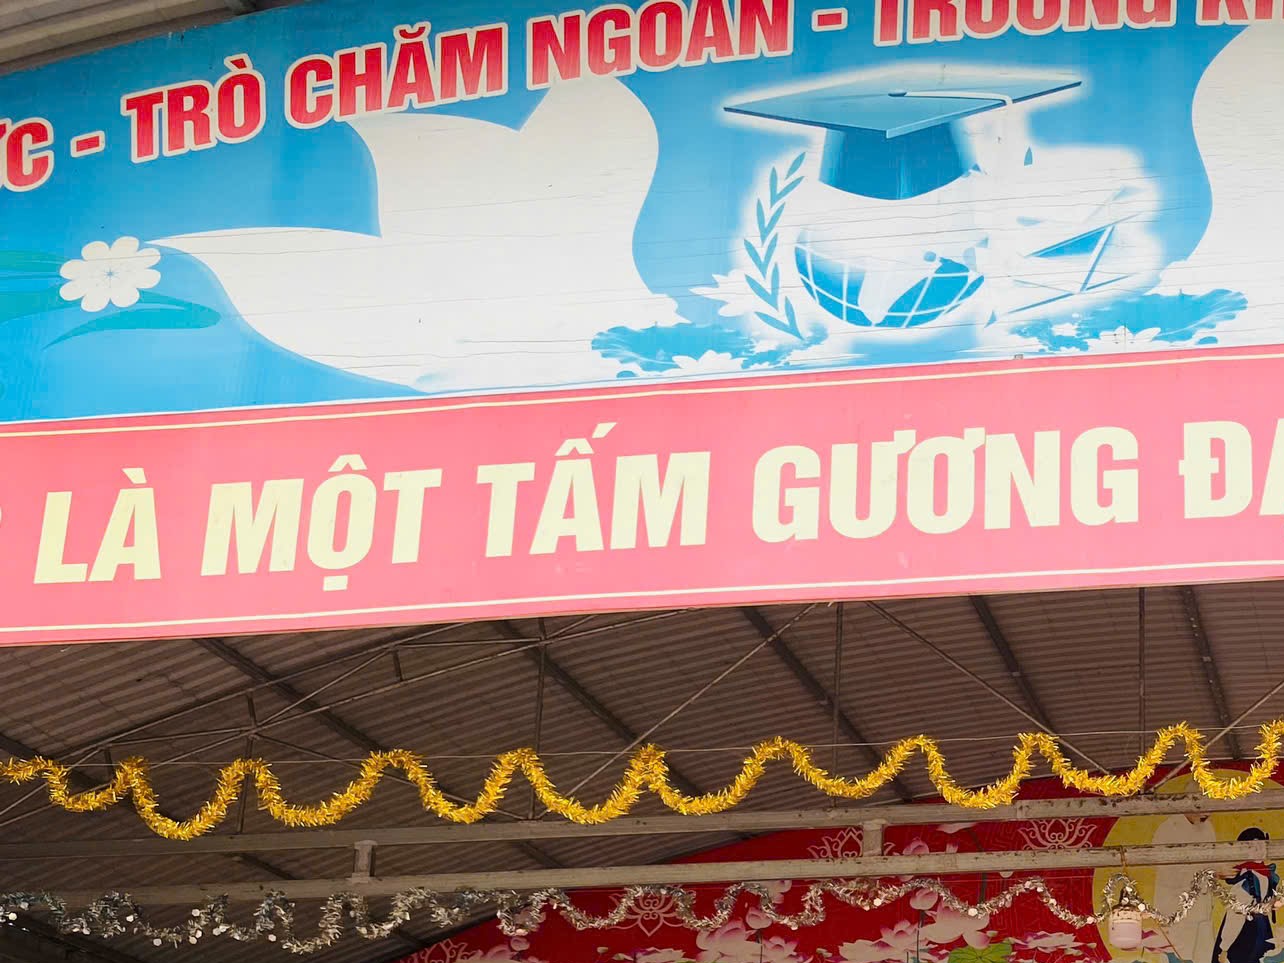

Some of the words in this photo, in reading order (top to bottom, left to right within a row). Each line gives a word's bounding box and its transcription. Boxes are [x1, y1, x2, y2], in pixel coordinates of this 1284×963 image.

[121, 54, 265, 163] TRÒ
[285, 20, 507, 129] CHĂM
[527, 0, 793, 90] NGOAN
[33, 468, 162, 585] LÀ
[200, 455, 441, 592] MỘT
[476, 423, 711, 559] TẤM
[751, 426, 1139, 543] GƯƠNG
